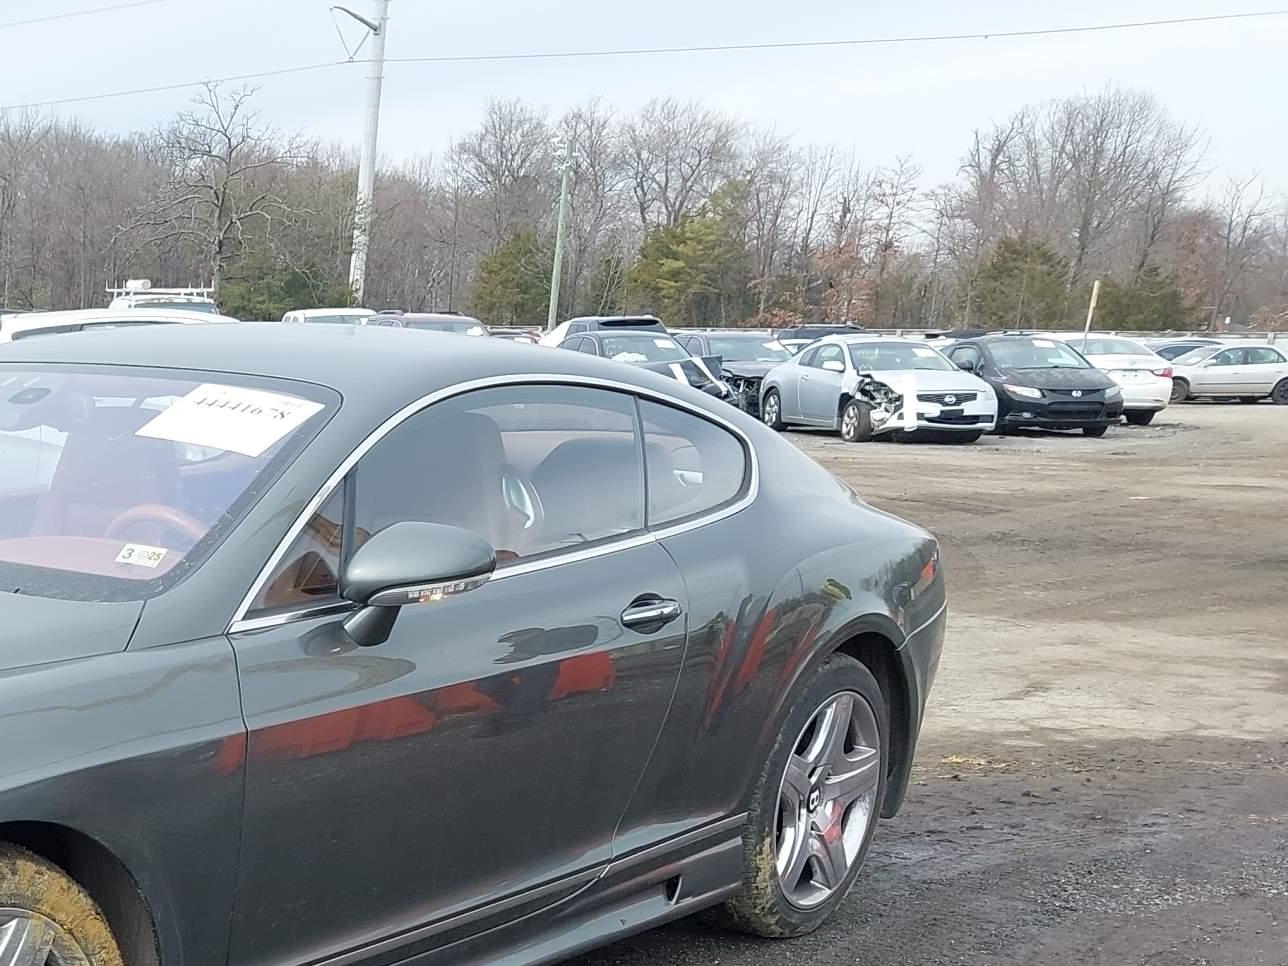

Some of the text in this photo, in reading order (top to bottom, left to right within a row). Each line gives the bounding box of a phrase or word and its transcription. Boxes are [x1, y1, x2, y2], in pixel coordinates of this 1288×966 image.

[193, 397, 292, 420] 44441678
[121, 548, 163, 561] 3 25
